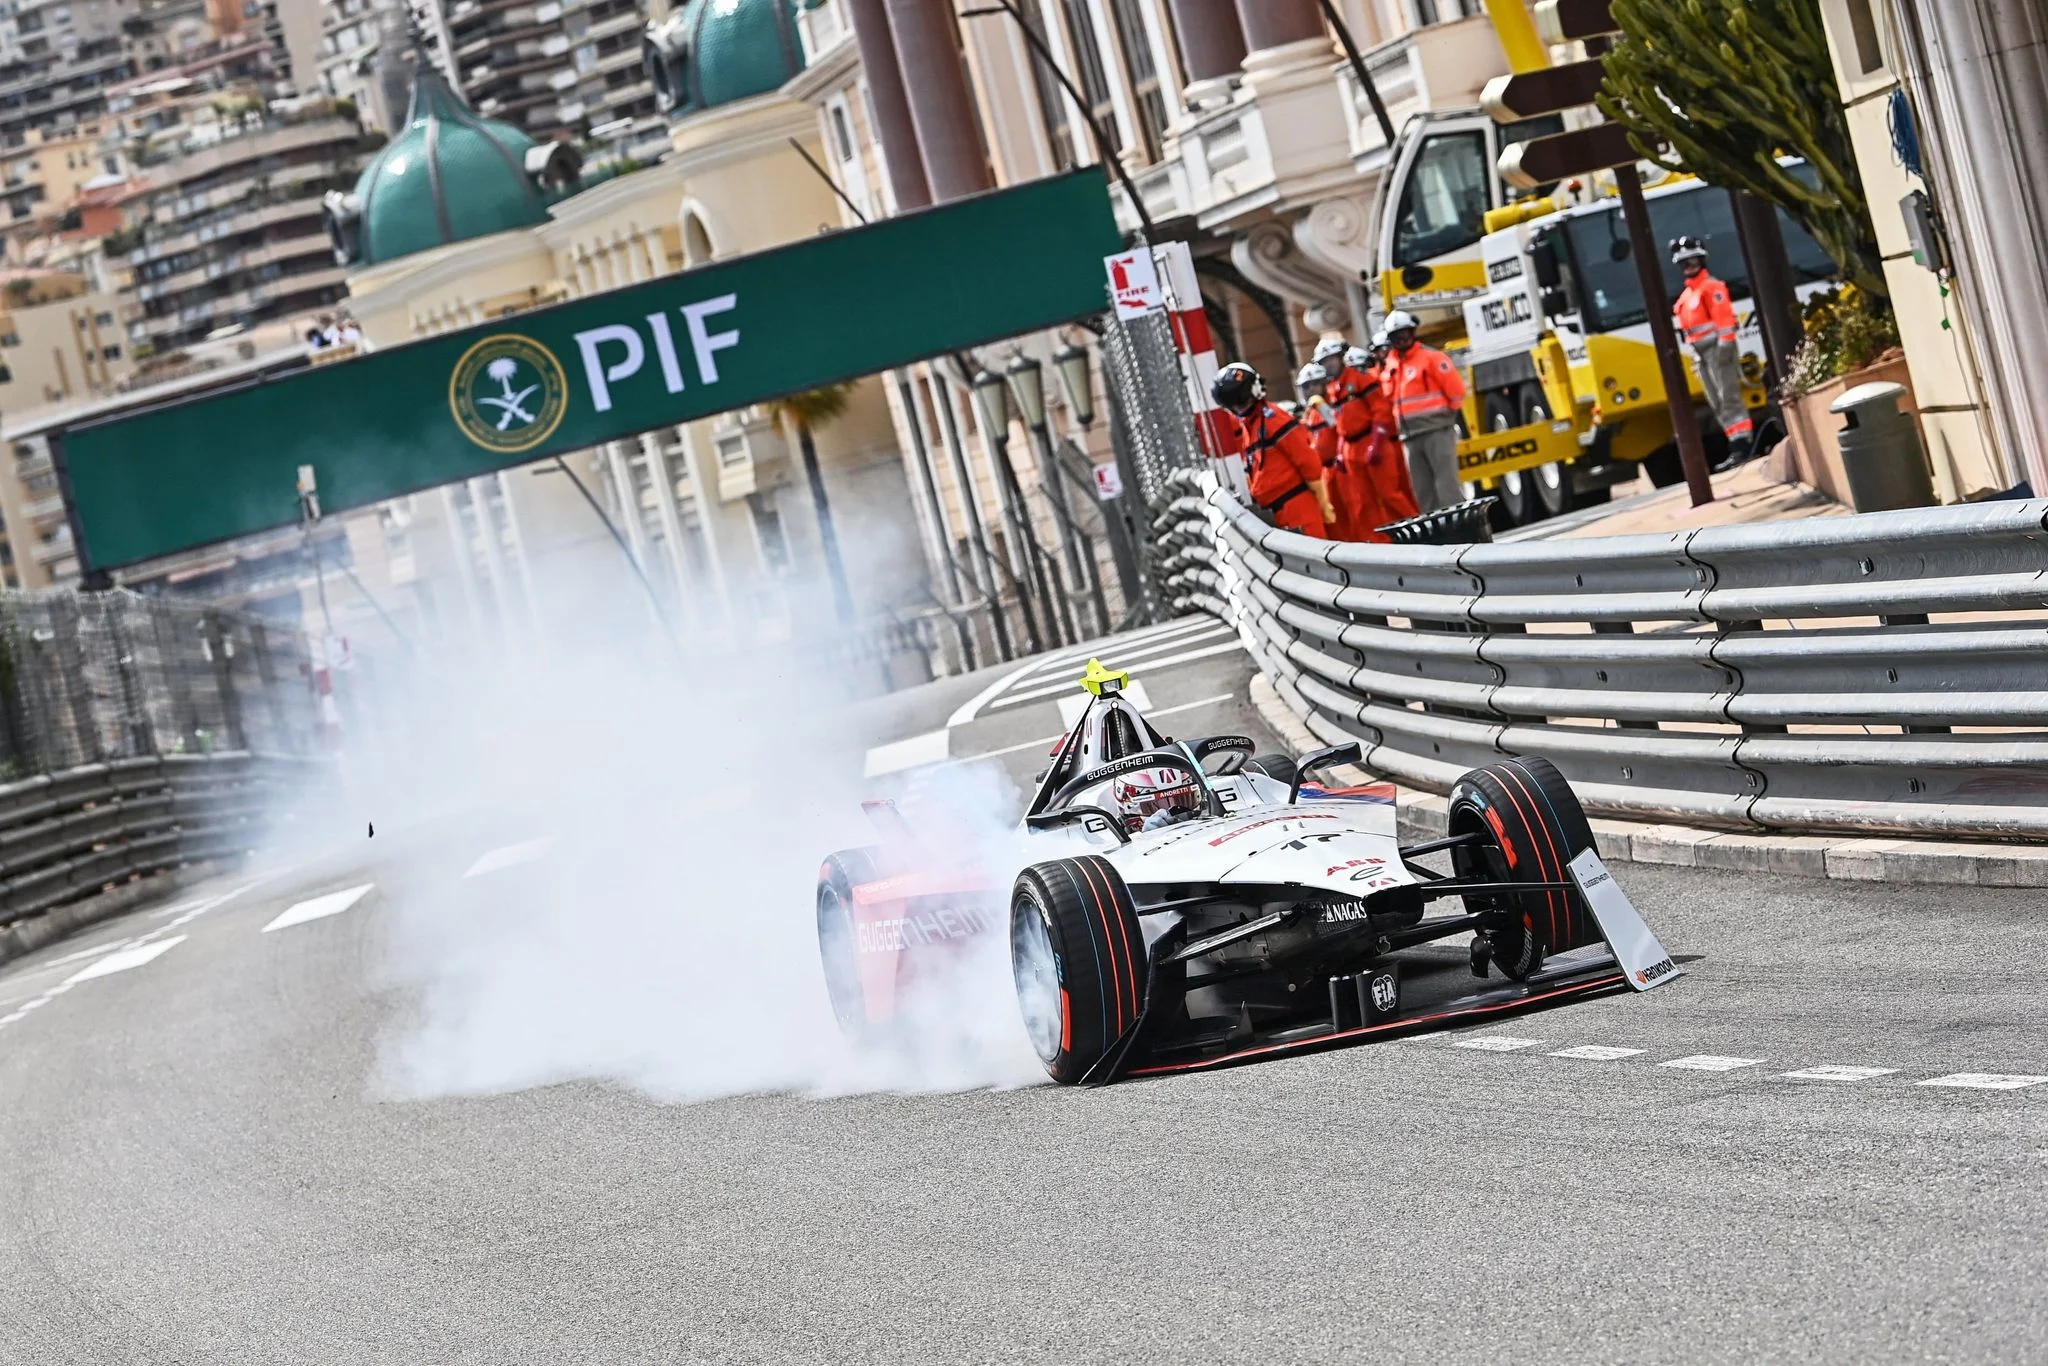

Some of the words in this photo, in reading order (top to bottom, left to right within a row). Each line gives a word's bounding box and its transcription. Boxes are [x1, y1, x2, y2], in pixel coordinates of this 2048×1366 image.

[1117, 286, 1149, 299] FIRE
[573, 293, 740, 412] PIF
[1087, 755, 1154, 781] GUGGENHEIM
[1160, 786, 1189, 799] ANDRETTI
[858, 904, 990, 953] GUGGENHEIM
